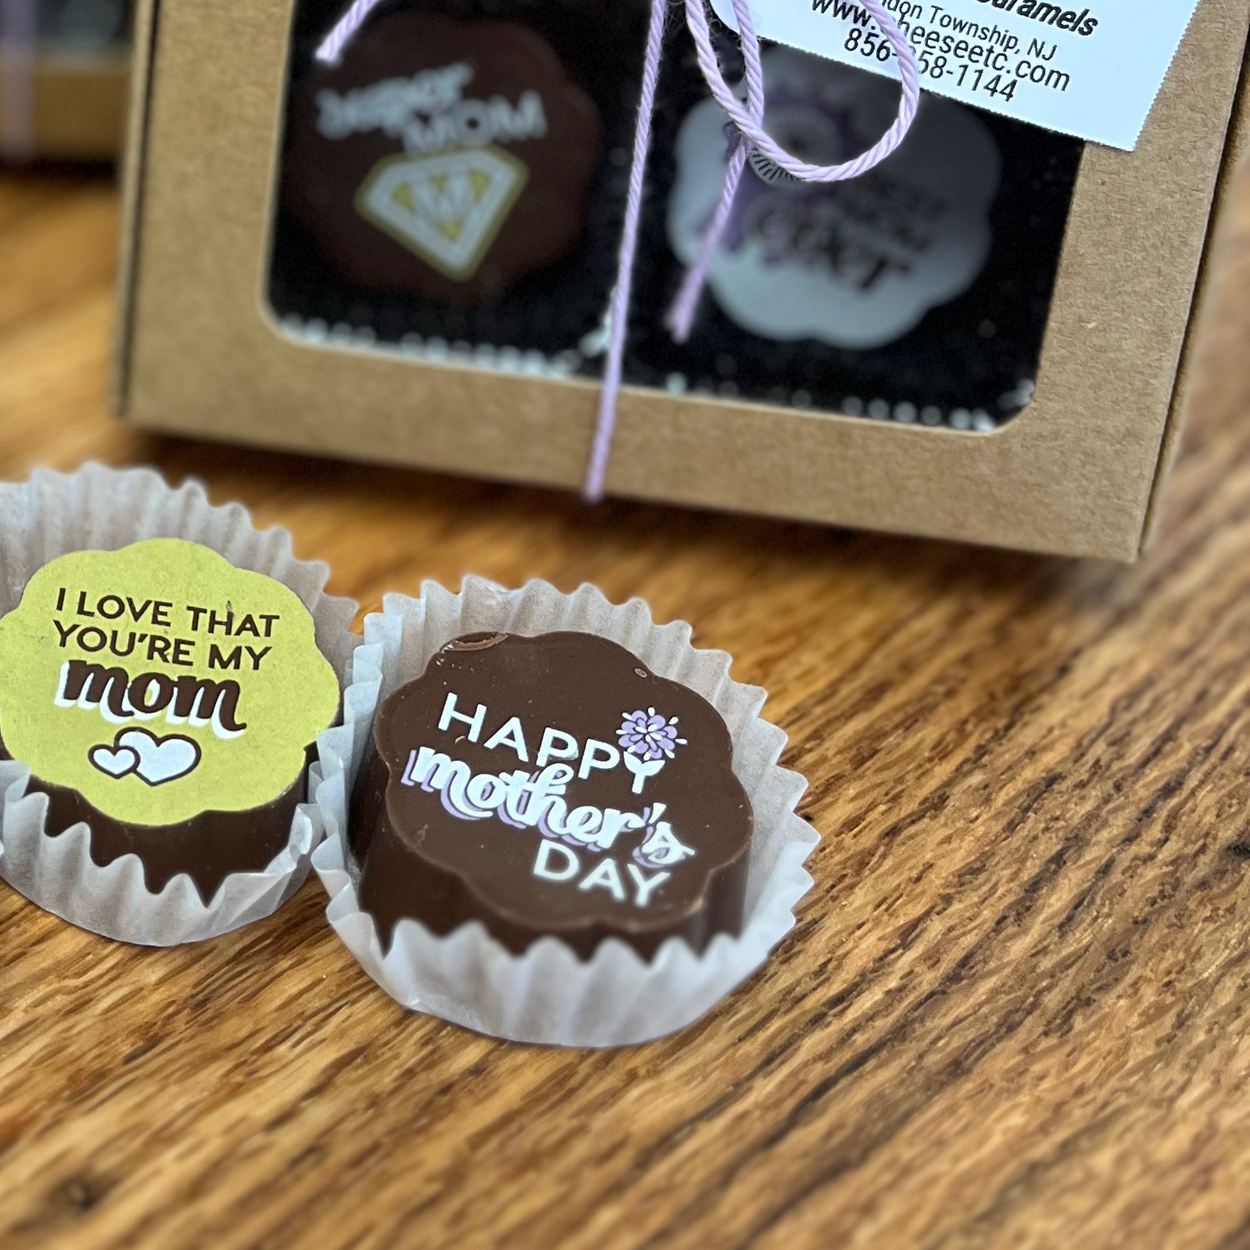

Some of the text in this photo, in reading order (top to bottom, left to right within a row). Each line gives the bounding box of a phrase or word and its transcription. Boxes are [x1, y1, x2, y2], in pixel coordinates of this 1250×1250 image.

[844, 28, 1018, 102] 856-58-1144
[930, 5, 1020, 54] Township,
[1027, 38, 1058, 61] NJ
[53, 620, 273, 670] YOU'RE MY
[56, 588, 280, 638] I LOVE THAT
[57, 659, 248, 735] mom
[438, 692, 666, 794] HAPPY
[404, 746, 695, 868] mother's
[533, 839, 671, 907] DAY
